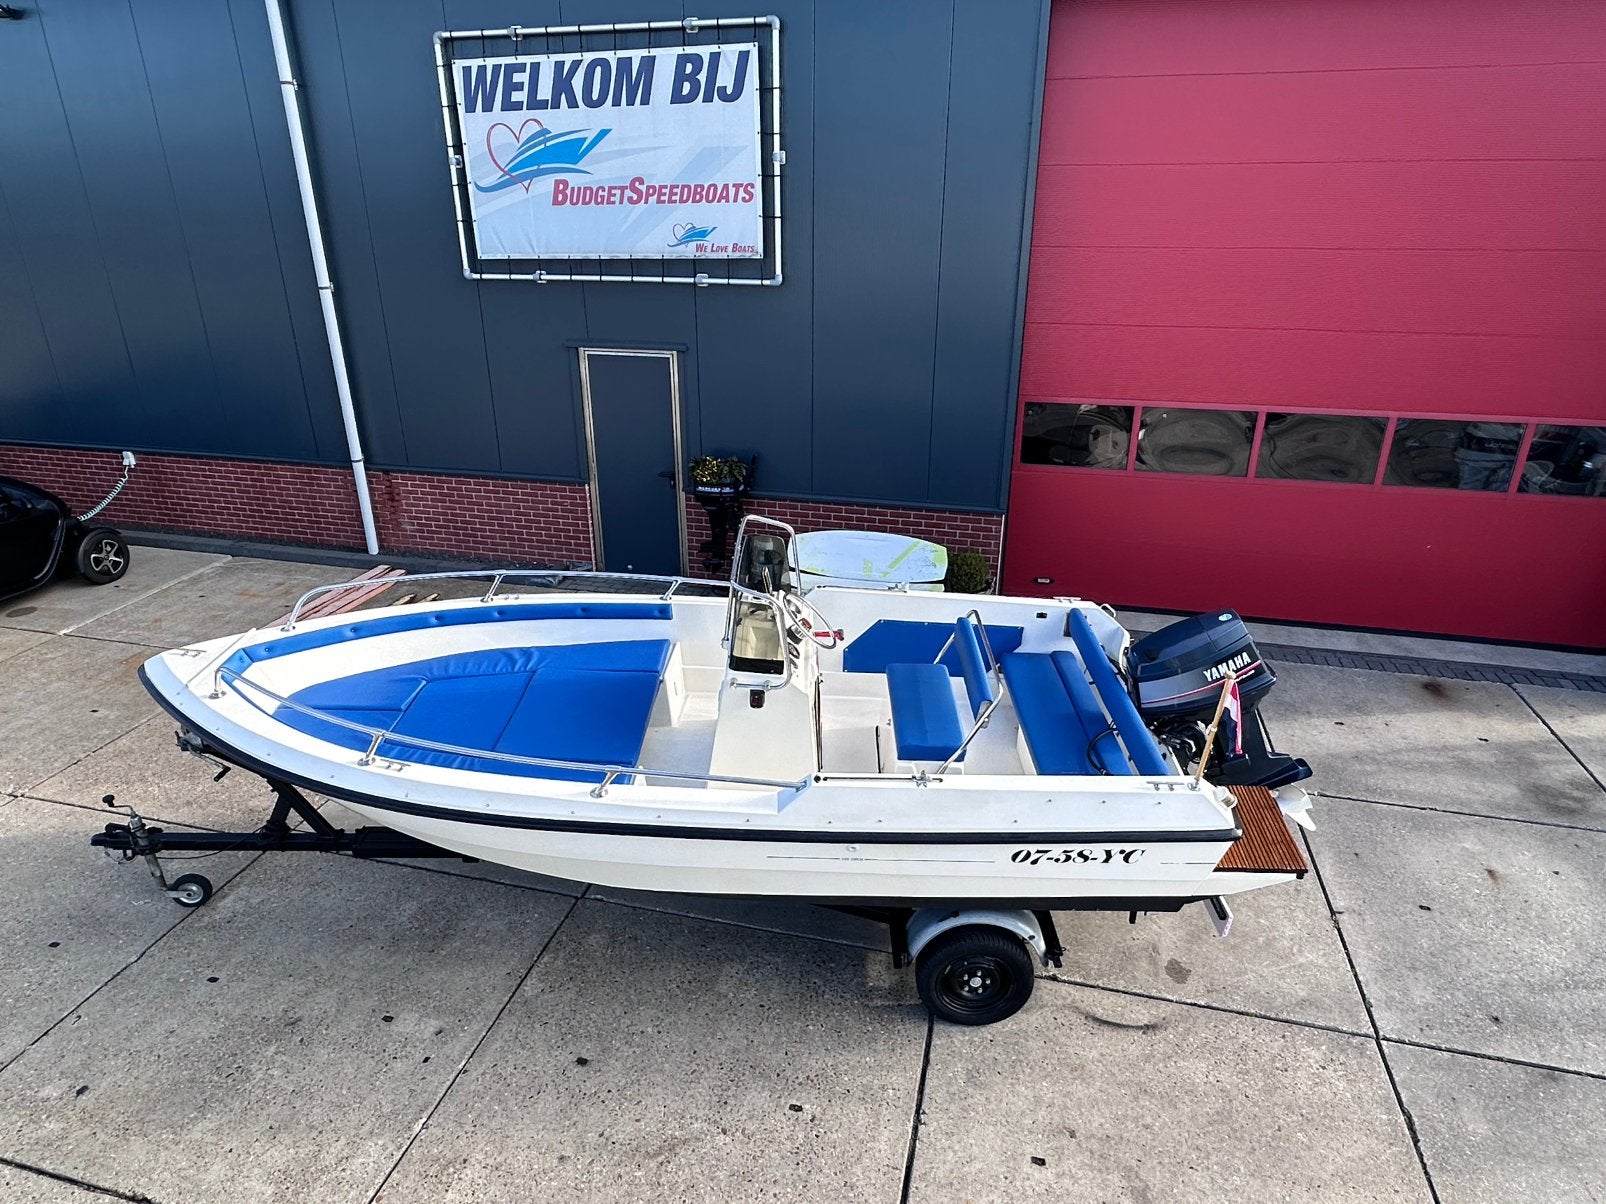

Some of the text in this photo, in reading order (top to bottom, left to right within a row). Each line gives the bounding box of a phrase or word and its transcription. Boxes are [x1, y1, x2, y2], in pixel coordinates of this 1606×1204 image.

[462, 50, 750, 113] WELKOM BIJ
[1203, 651, 1251, 682] YAMAHA
[1010, 849, 1146, 866] 07-58-YC
